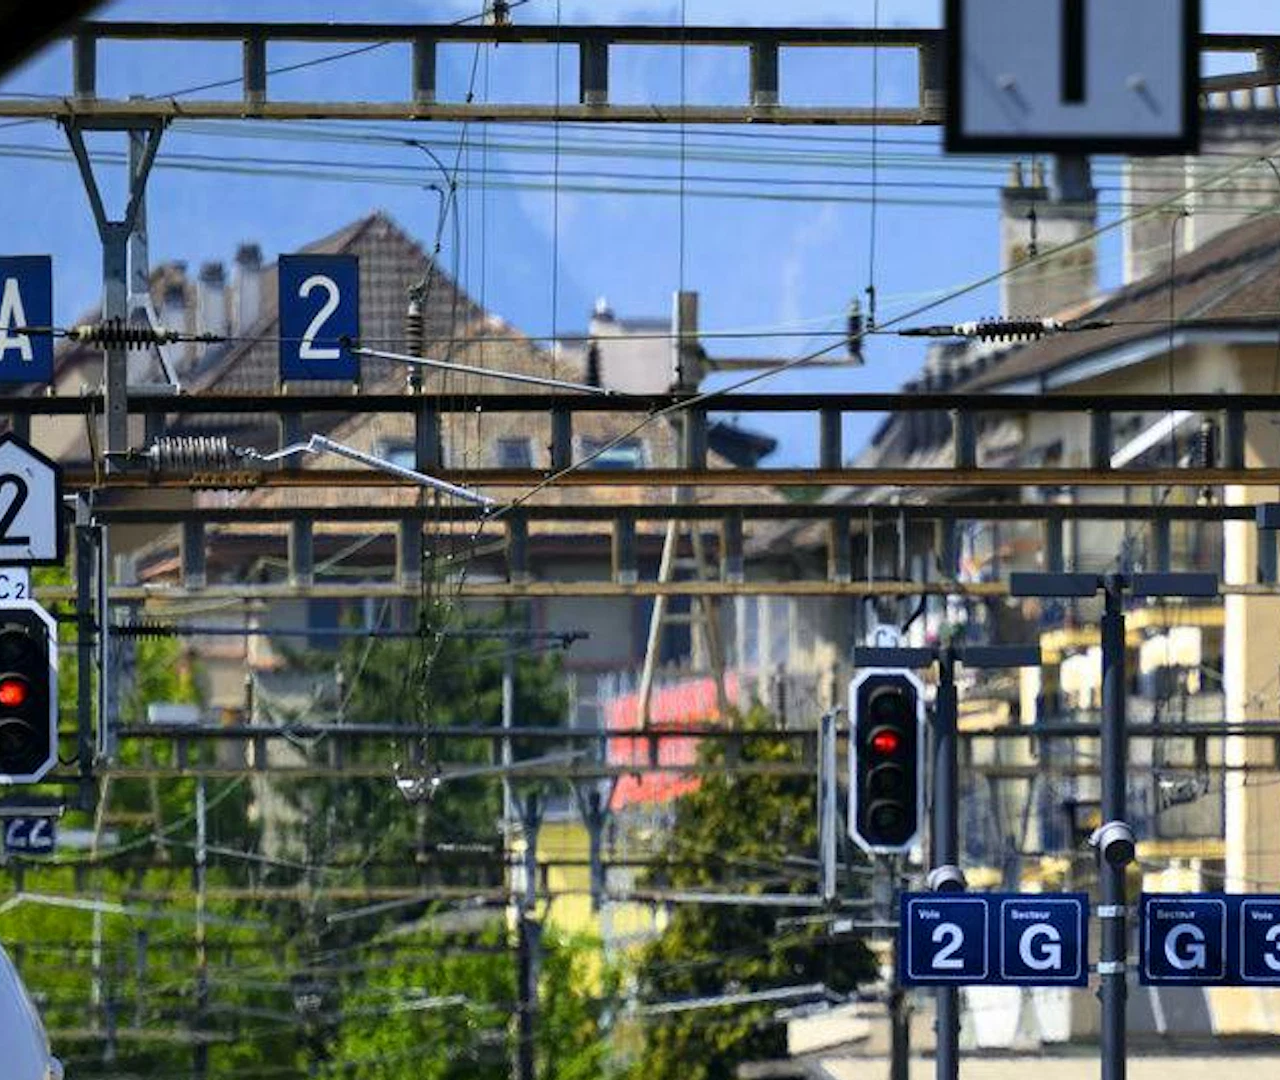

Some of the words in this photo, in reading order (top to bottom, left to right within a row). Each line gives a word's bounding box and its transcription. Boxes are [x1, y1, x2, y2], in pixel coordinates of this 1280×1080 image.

[298, 275, 342, 360] 2
[918, 908, 942, 920] Voie
[1010, 909, 1051, 921] Secteur
[1251, 910, 1275, 922] Voie
[930, 922, 965, 969] 2
[1018, 922, 1062, 970] G
[1163, 923, 1207, 970] G
